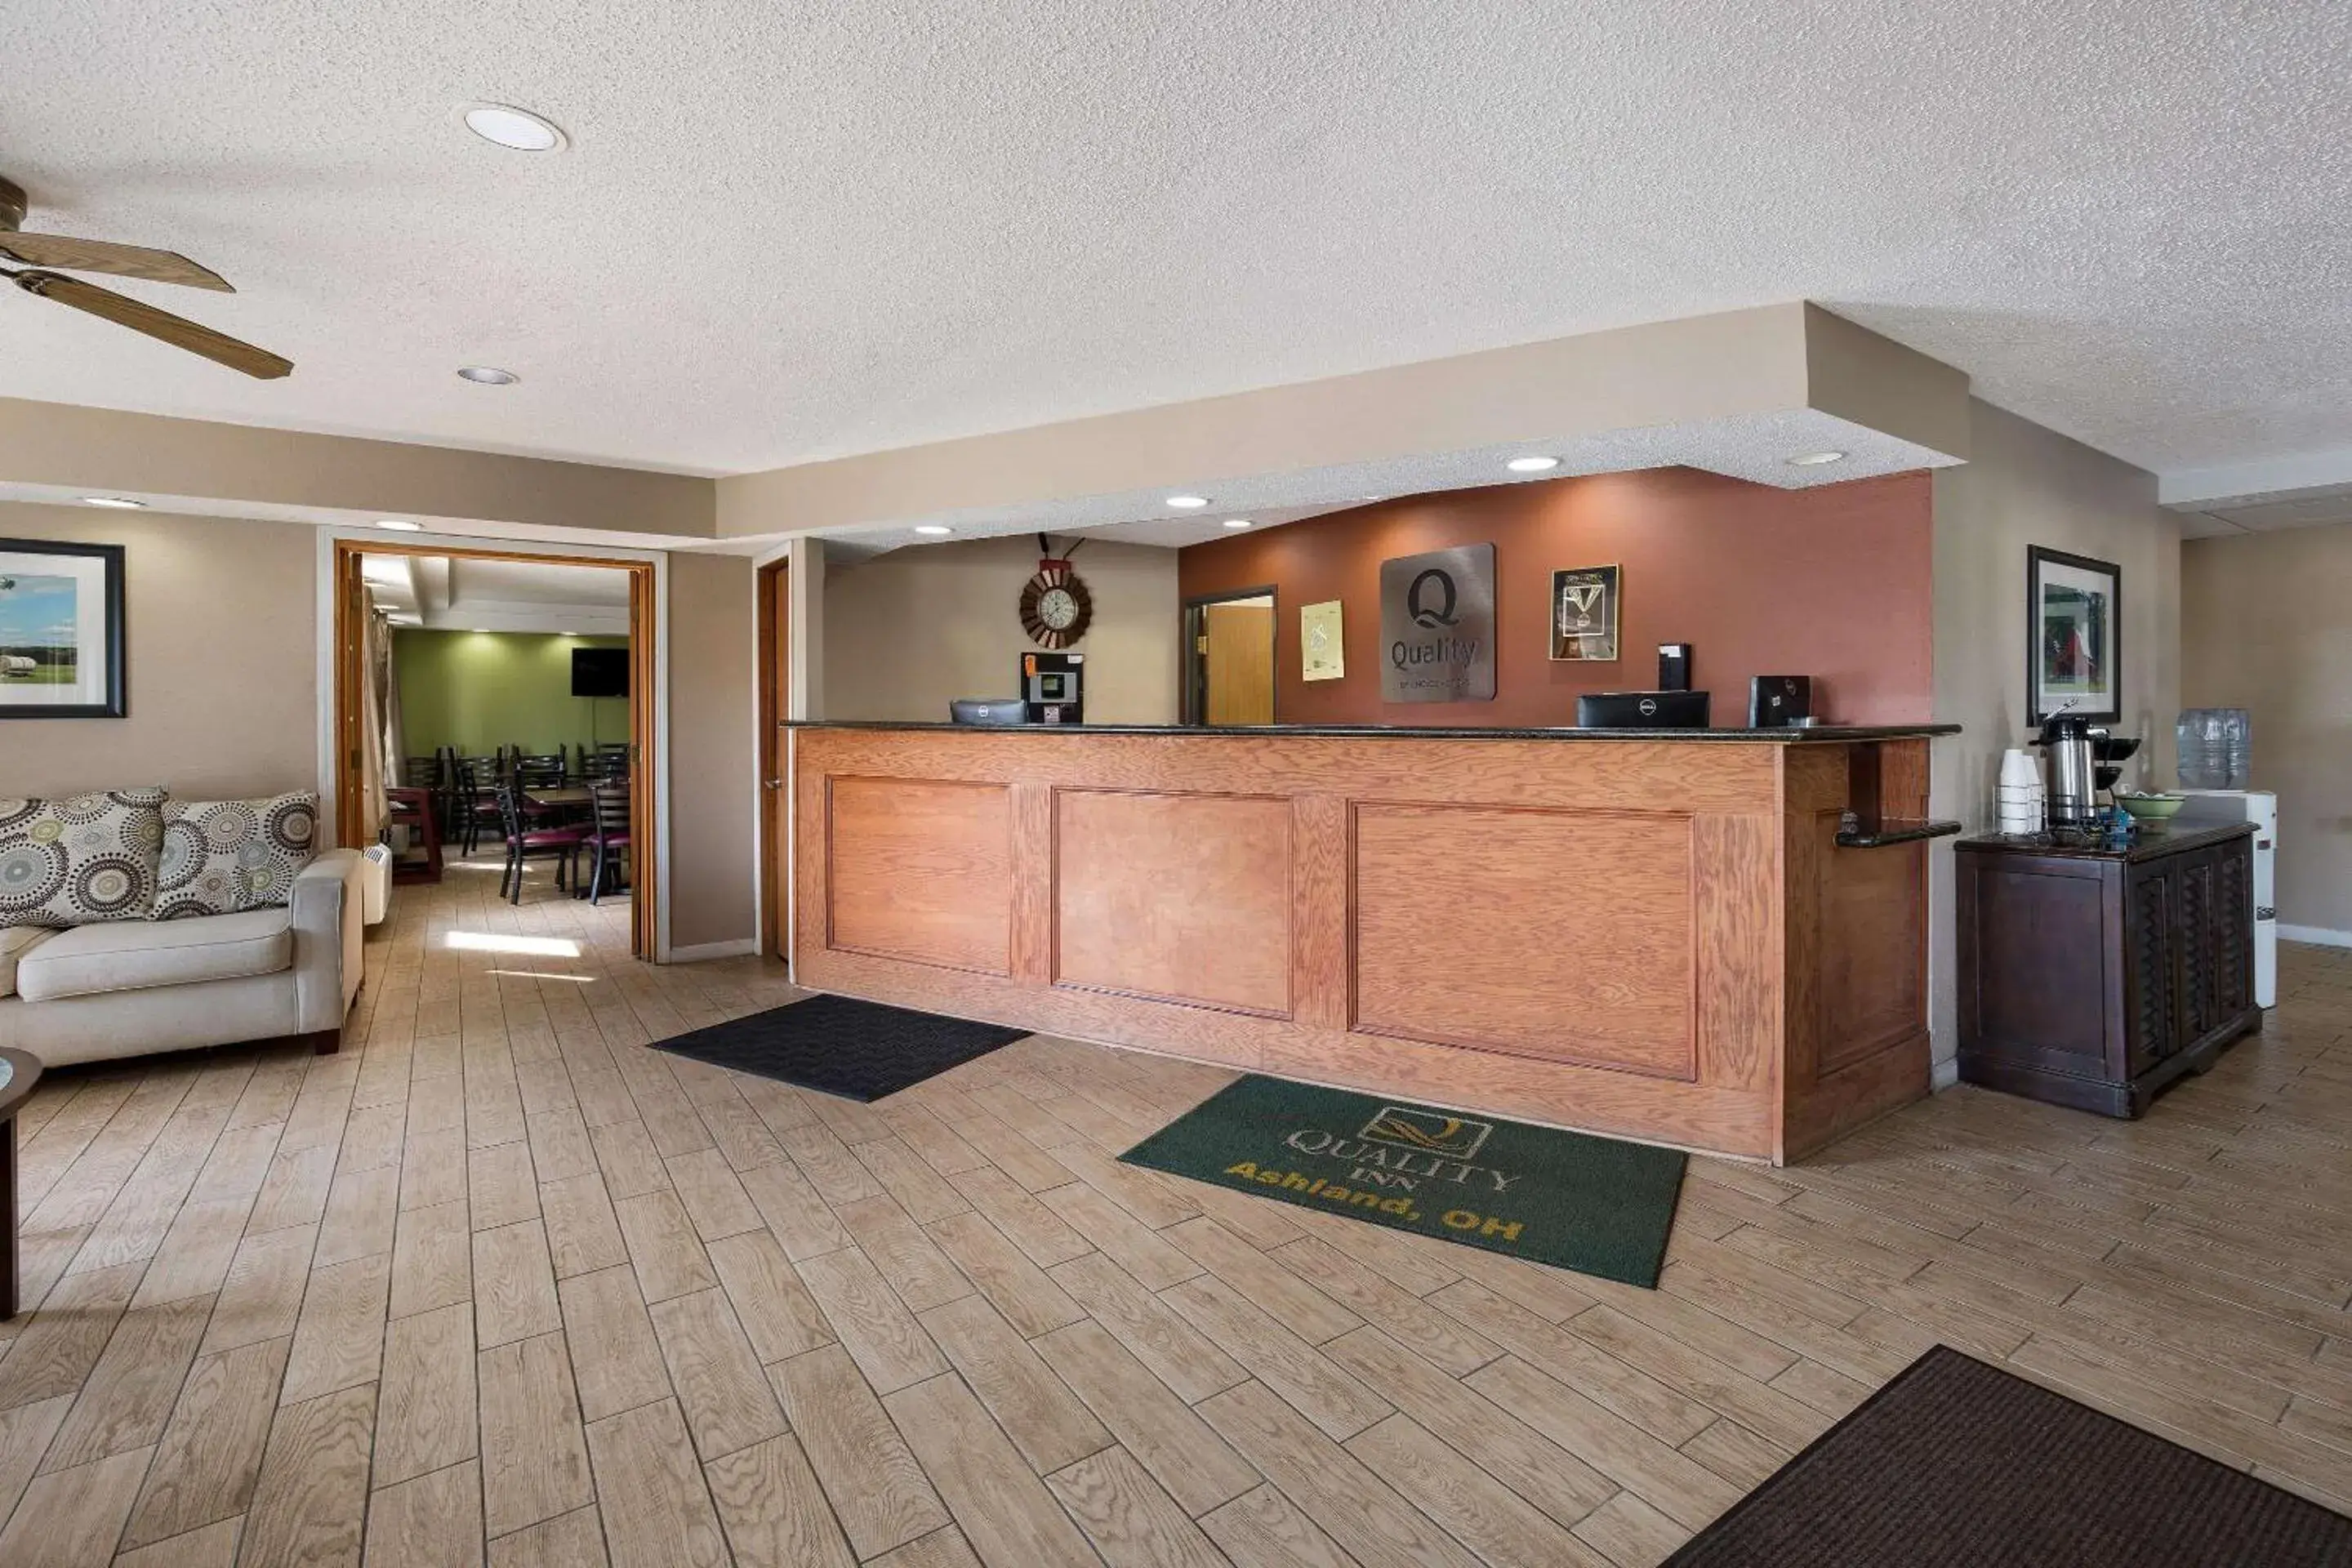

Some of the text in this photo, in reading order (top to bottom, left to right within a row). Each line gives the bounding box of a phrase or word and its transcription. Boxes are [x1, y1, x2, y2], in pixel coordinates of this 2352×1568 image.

[1407, 569, 1460, 629] Q
[1392, 638, 1476, 671] Quality
[1284, 1129, 1522, 1192] QUALITY
[1349, 1168, 1420, 1192] INN
[1225, 1162, 1523, 1241] Ashland, OH
